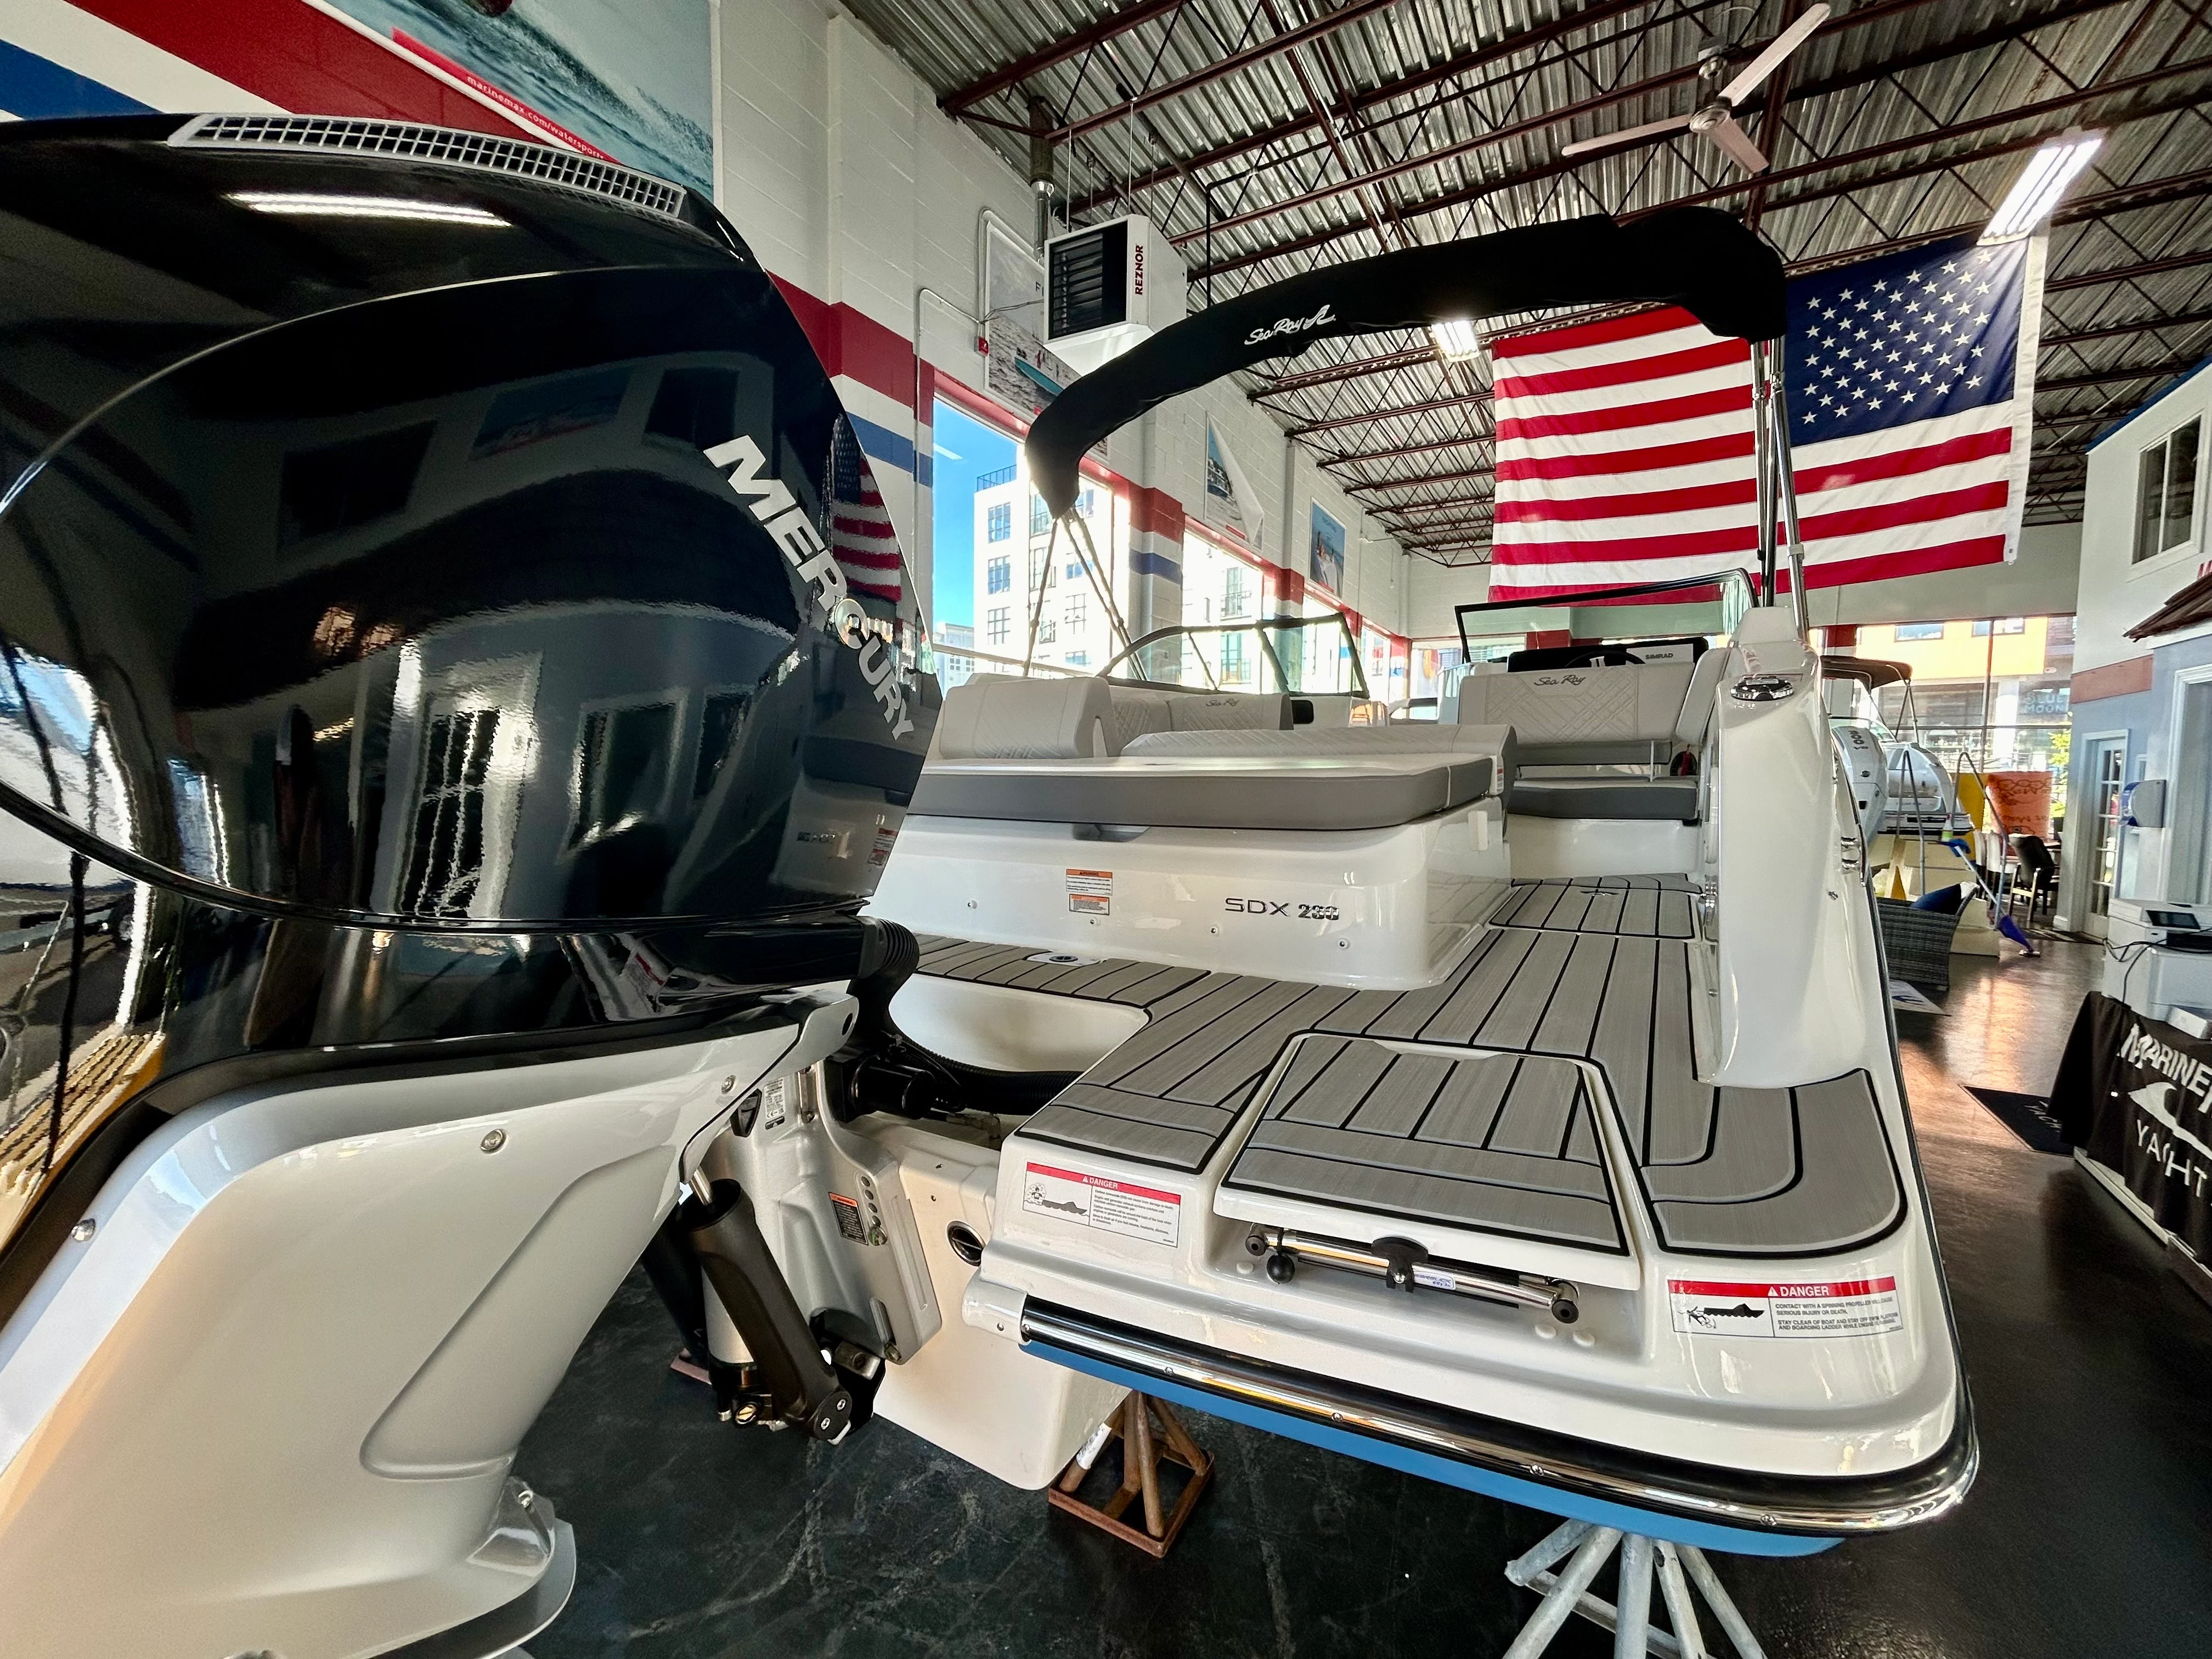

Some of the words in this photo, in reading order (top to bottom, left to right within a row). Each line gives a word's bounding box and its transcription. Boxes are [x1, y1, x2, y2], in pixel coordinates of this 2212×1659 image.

[1135, 245, 1143, 295] REZNOR
[1244, 328, 1273, 345] Sea
[1273, 318, 1305, 334] Ray
[703, 435, 914, 740] MERCURY
[1534, 676, 1559, 686] Sea
[1561, 674, 1587, 685] Ray
[2024, 704, 2064, 713] MOON
[1225, 898, 1290, 917] SDX
[2024, 1104, 2062, 1133] YACH
[1089, 1177, 1119, 1190] DANGER
[1779, 1285, 1830, 1296] DANGER
